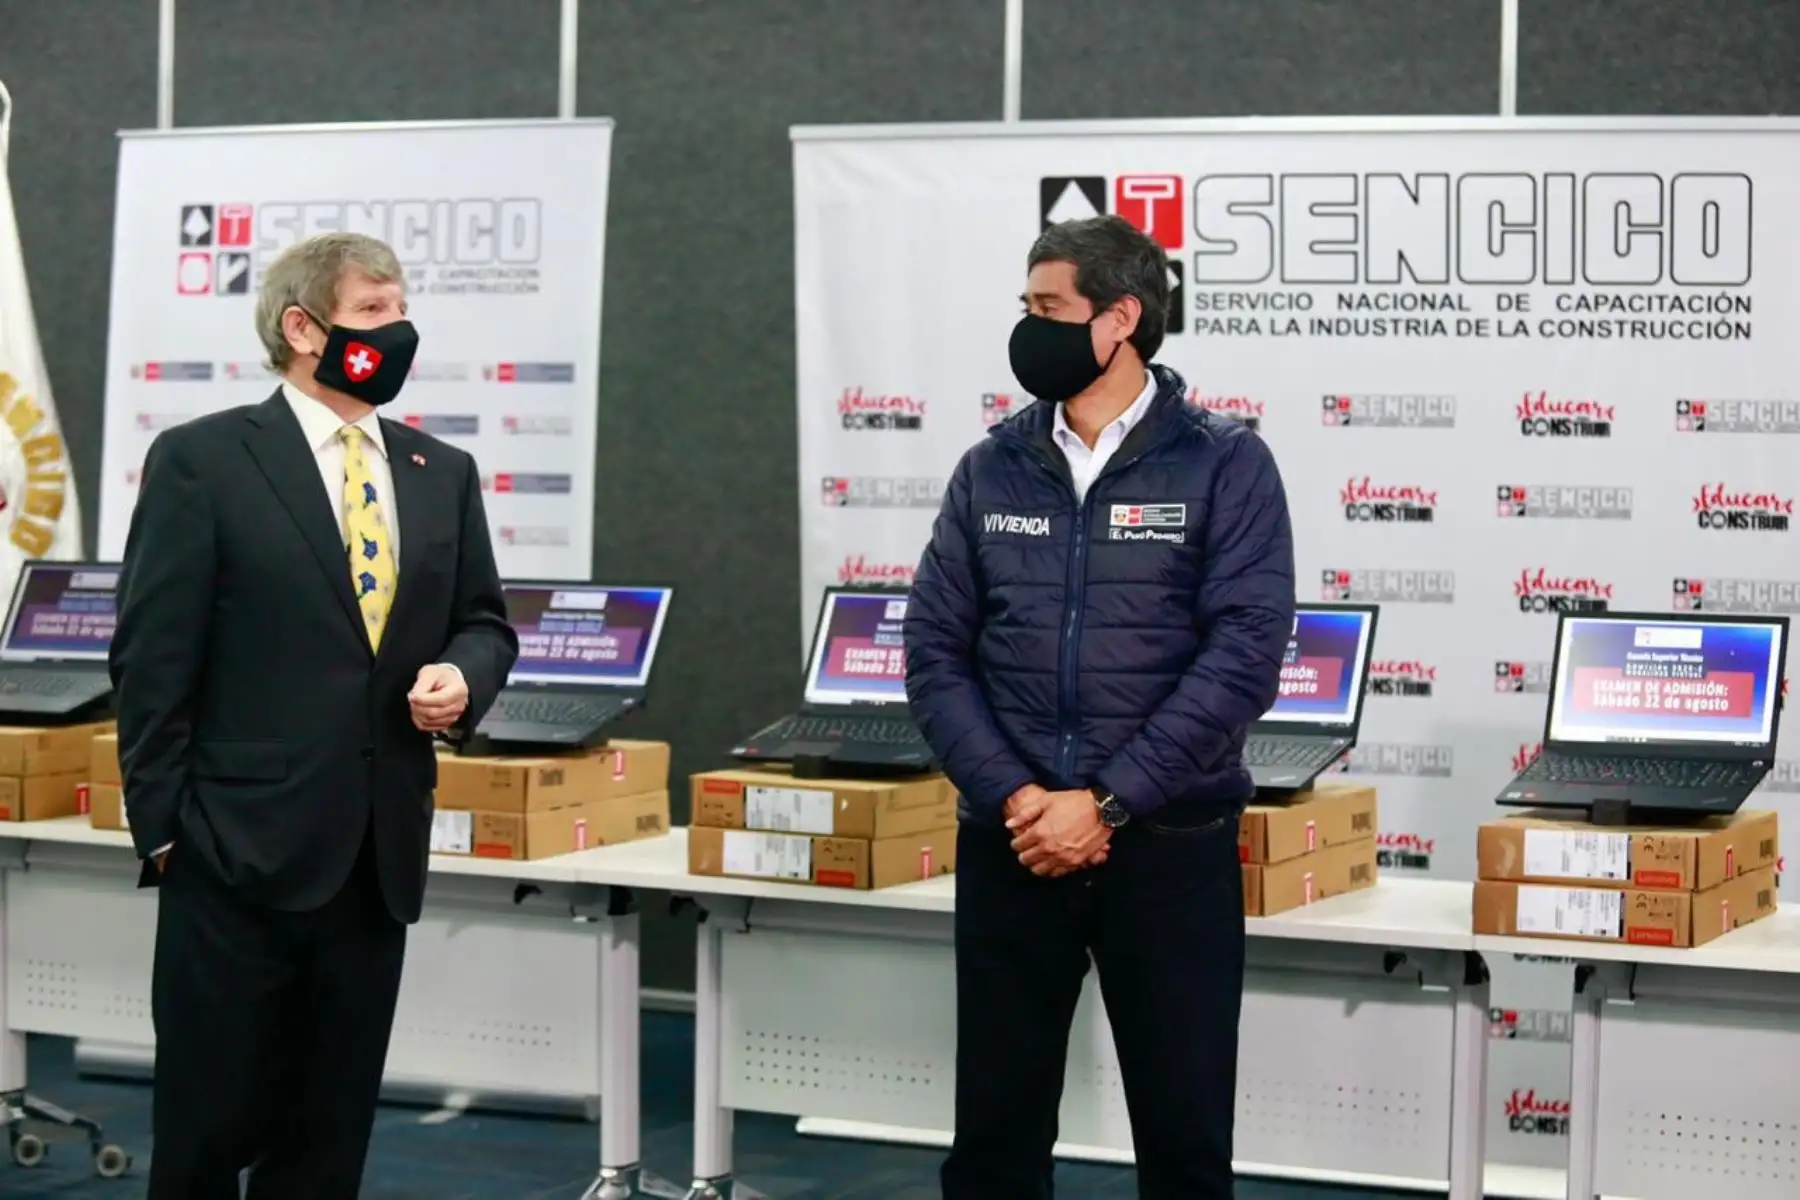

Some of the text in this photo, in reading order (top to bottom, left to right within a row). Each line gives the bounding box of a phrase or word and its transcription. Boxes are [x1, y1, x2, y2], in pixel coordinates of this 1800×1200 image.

[1194, 172, 1753, 286] SENCICO
[1195, 290, 1752, 314] SERVICIO NACIONAL DE CAPACITACIÓN
[1194, 316, 1752, 340] PARA LA INDUSTRIA DE LA CONSTRUCCIÓN
[1351, 395, 1455, 417] SENCICO
[1707, 400, 1800, 422] SENCIC
[1528, 486, 1632, 509] SENCICO
[984, 513, 1050, 537] VIVIENDA
[1350, 569, 1455, 593] SENCICO
[1593, 679, 1641, 692] EXAMEN
[1645, 681, 1660, 693] DE
[1593, 692, 1729, 713] Sábado 22 de agosto
